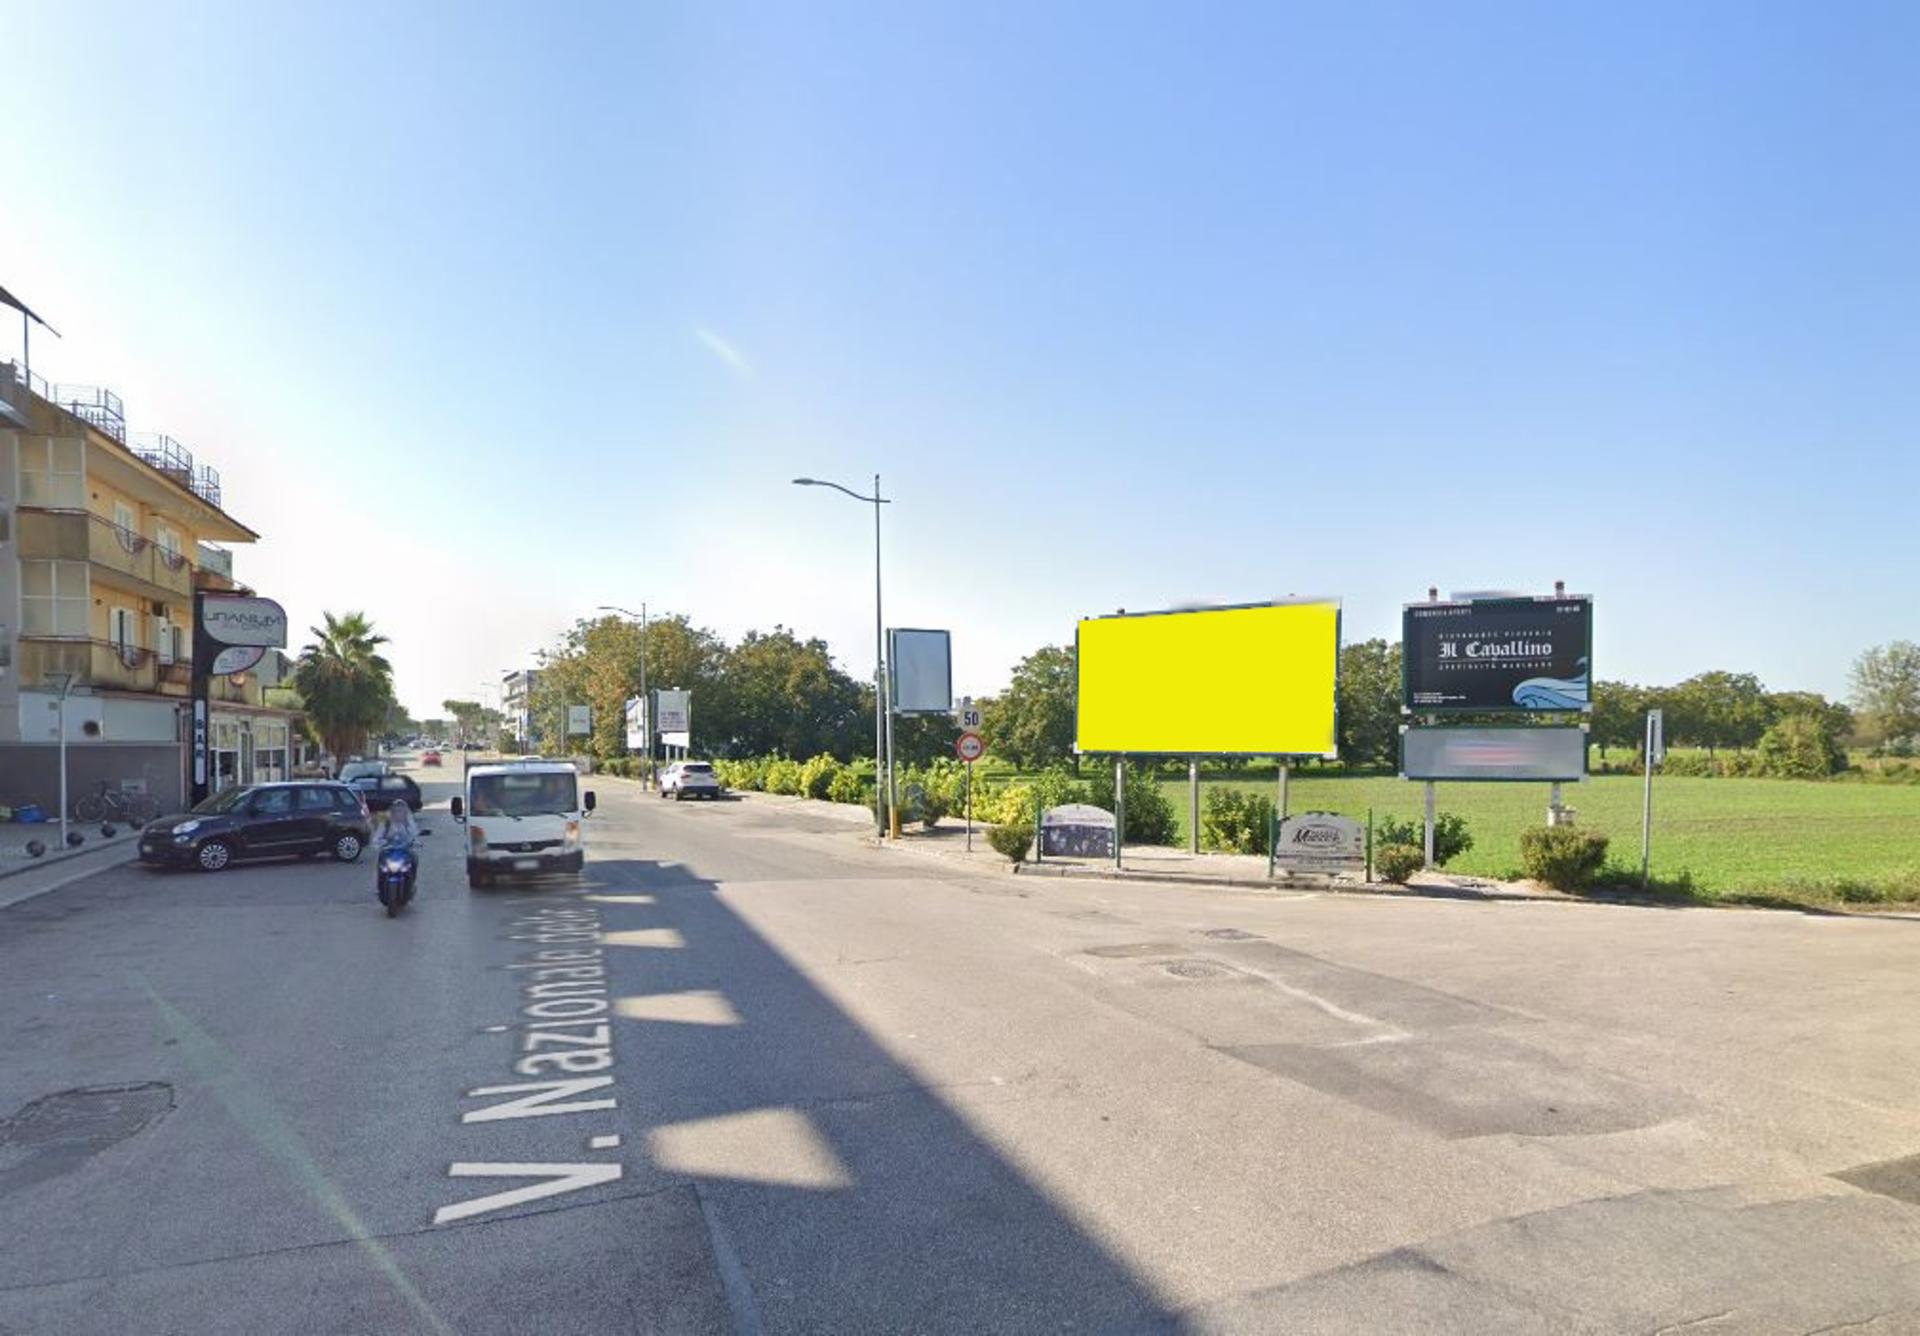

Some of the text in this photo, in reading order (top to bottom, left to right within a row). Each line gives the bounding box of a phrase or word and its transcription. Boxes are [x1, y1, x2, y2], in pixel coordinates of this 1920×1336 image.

[1439, 641, 1552, 658] Il Cavallino
[965, 711, 979, 726] 50
